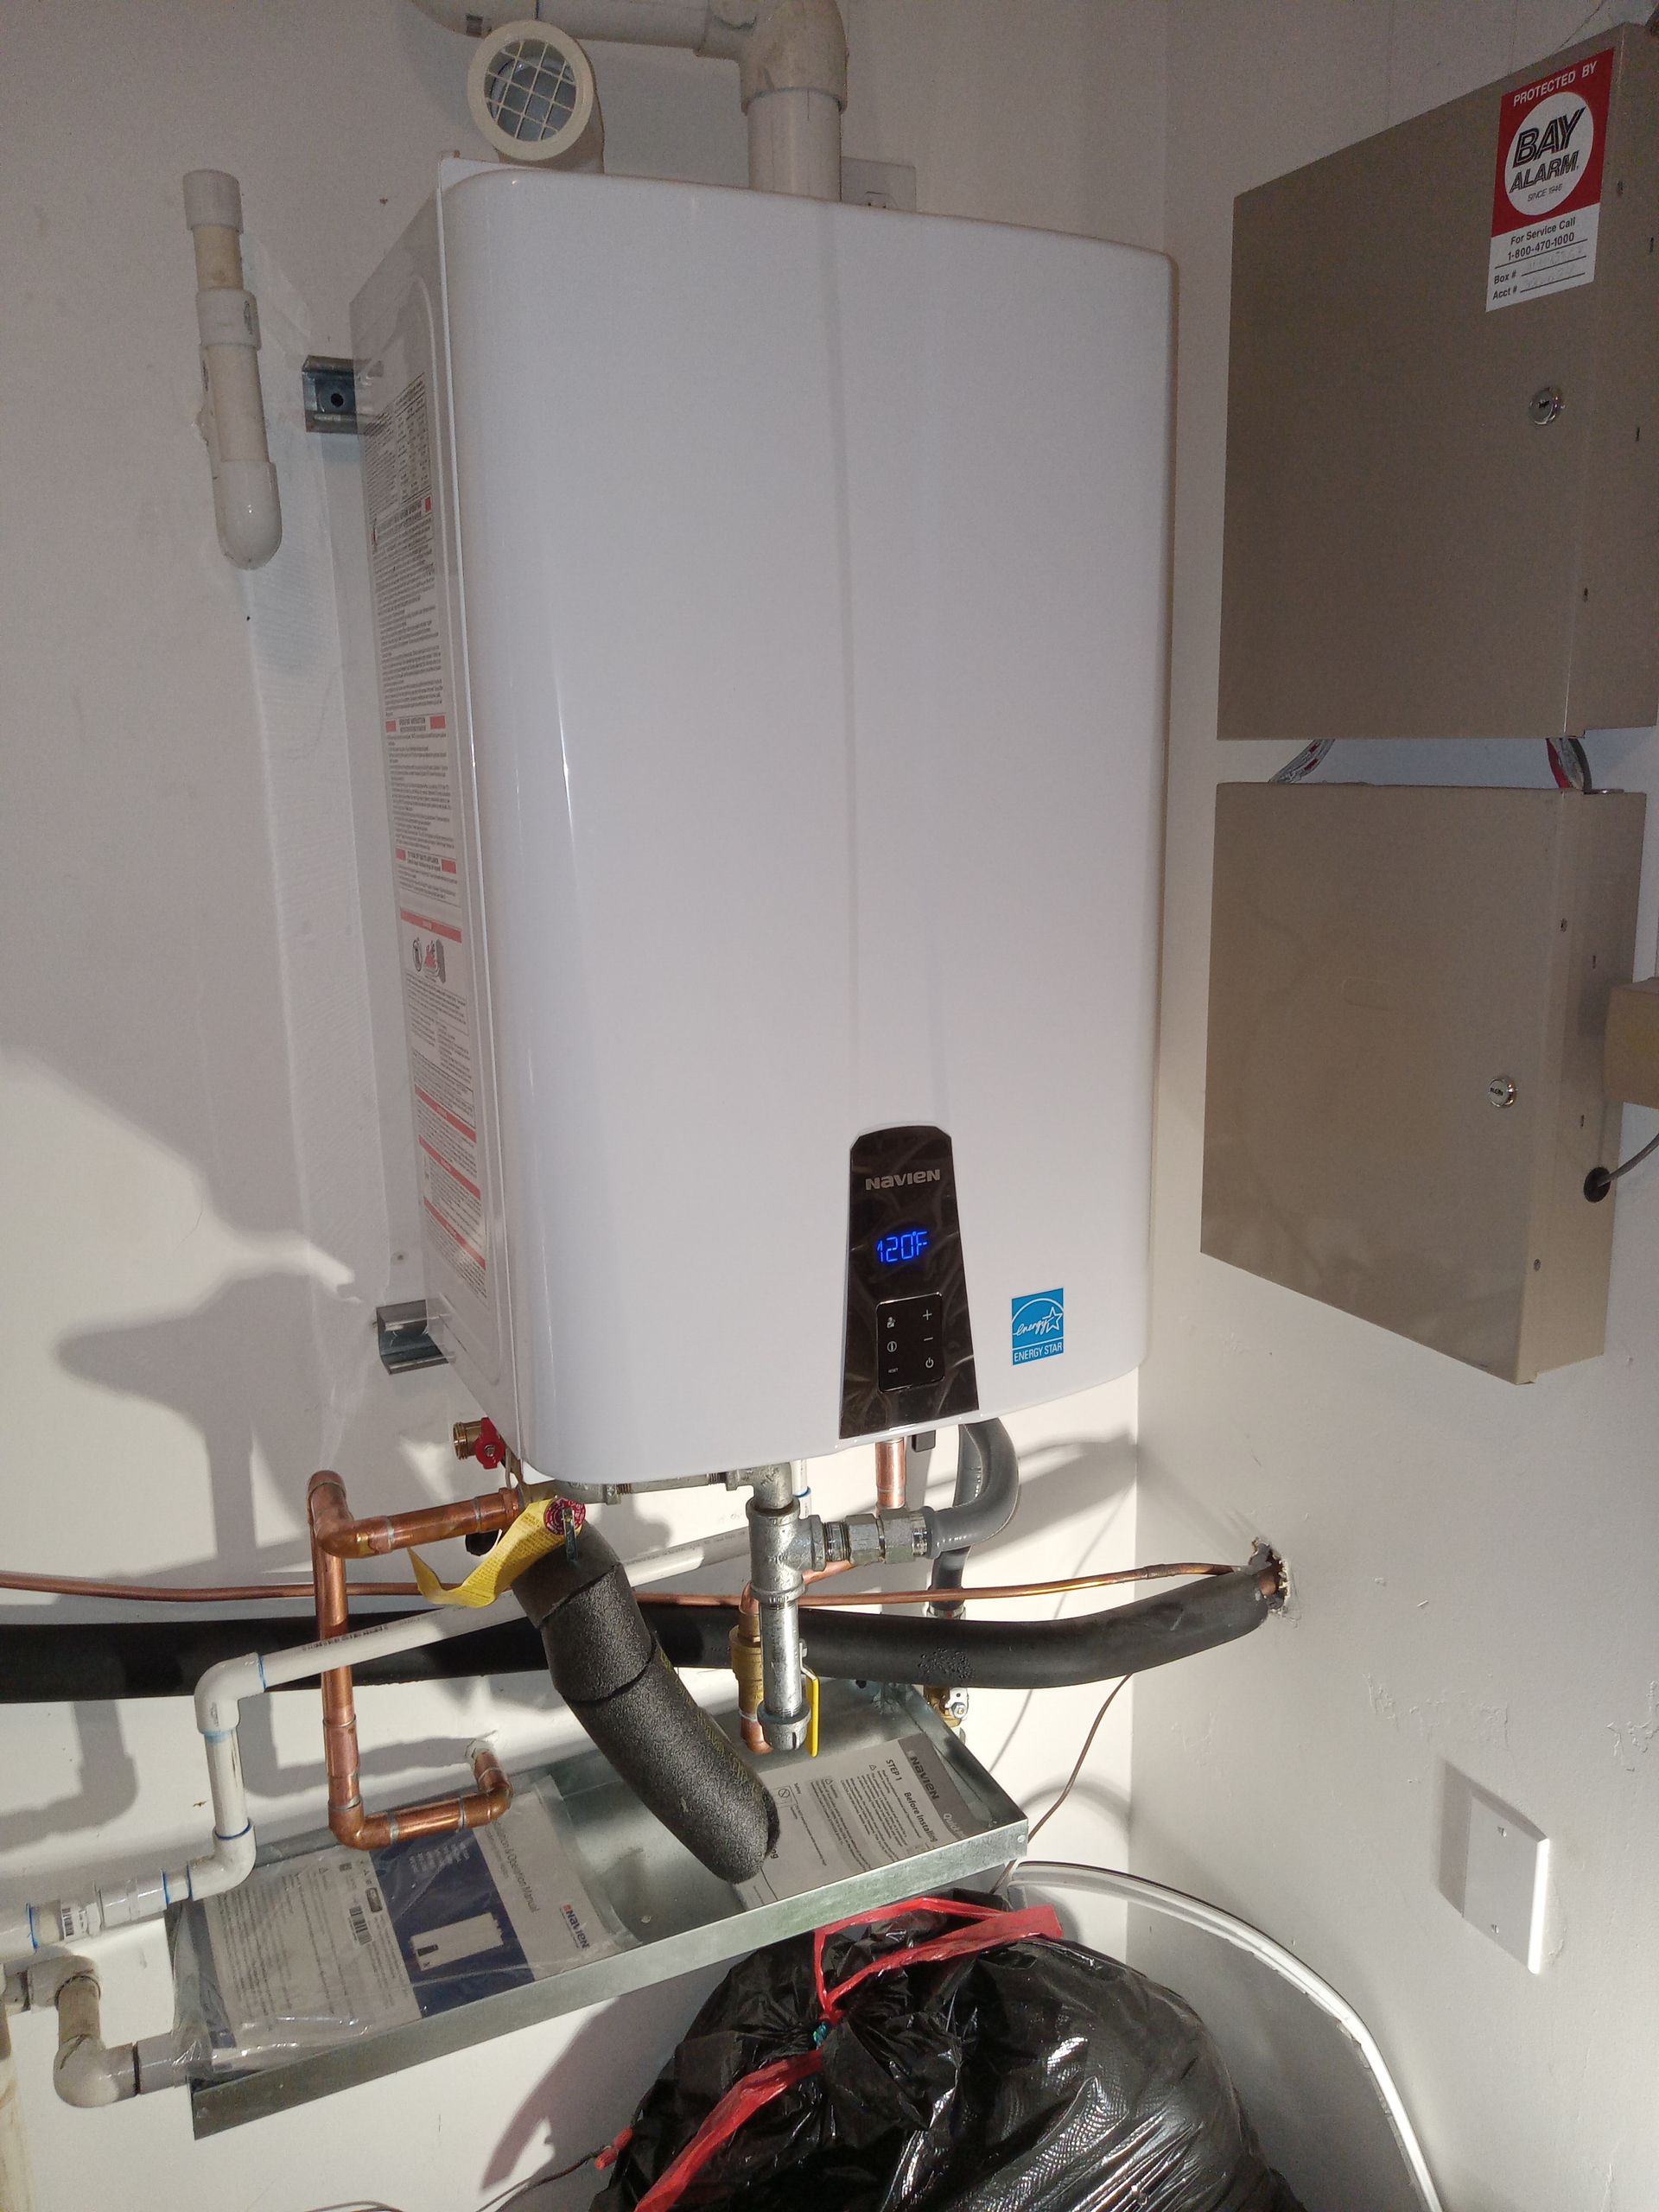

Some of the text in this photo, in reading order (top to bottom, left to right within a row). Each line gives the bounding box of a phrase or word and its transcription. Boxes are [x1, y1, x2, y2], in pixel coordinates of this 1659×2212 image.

[1514, 61, 1598, 106] PROTECTED BY
[1513, 106, 1586, 168] BAY
[1528, 188, 1547, 202] SINCE
[1510, 217, 1576, 245] For Service Call
[1508, 232, 1574, 261] 1-800-470-1000
[1494, 273, 1510, 284] Box
[1492, 288, 1510, 301] Acct
[1014, 1341, 1063, 1363] ENERGY STAR
[886, 1759, 900, 1777] STEP
[904, 1791, 920, 1815] Before
